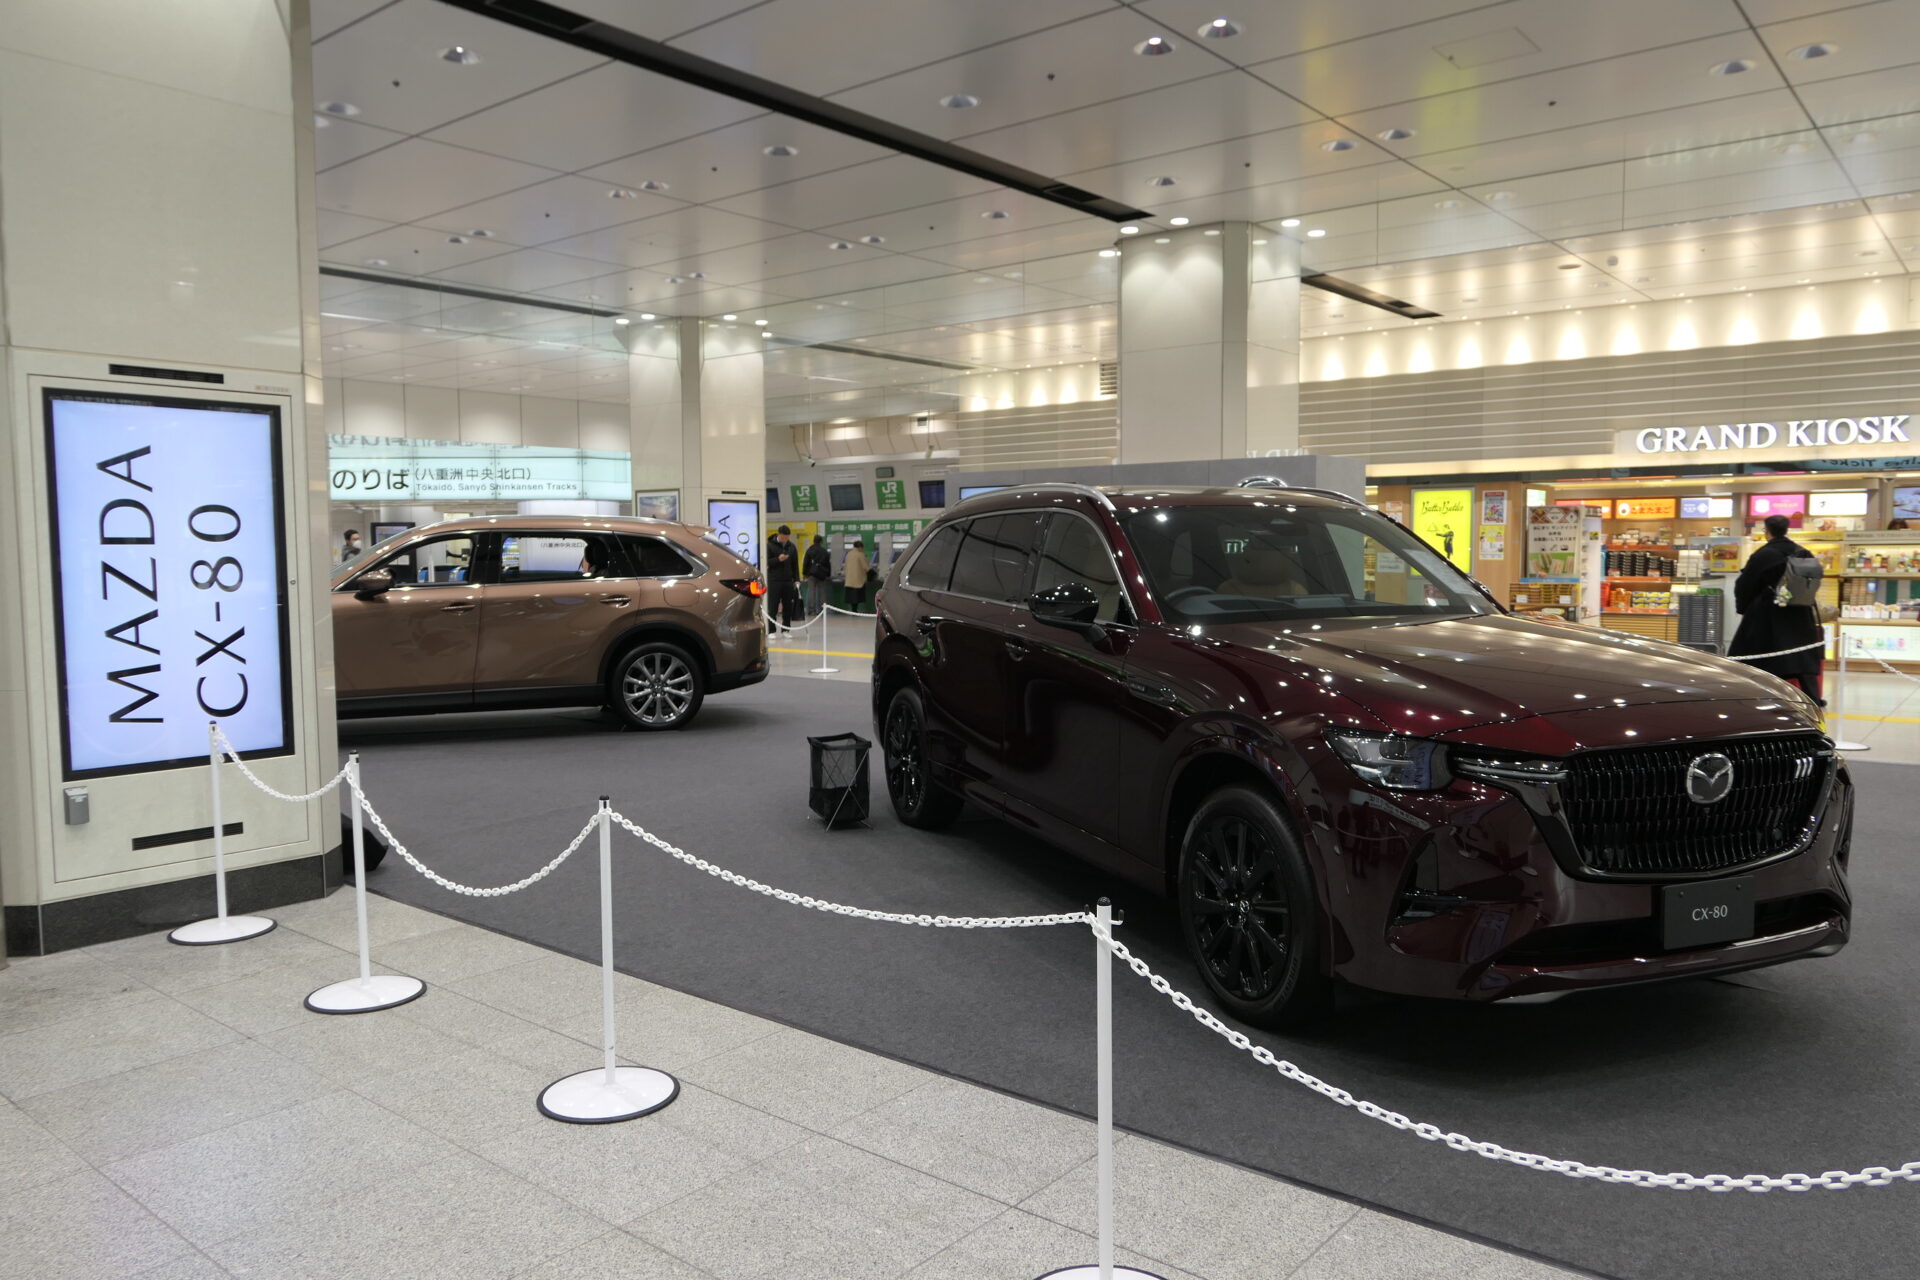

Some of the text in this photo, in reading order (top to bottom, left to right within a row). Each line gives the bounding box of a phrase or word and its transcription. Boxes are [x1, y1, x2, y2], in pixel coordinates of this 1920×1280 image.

[1636, 415, 1911, 453] GRAND KIOSK
[332, 468, 410, 491] のりば
[415, 467, 532, 481] (八重洲中央北口)
[489, 482, 544, 491] Shinkansen
[547, 482, 577, 491] Tracks
[796, 486, 811, 497] JR
[882, 482, 897, 493] JR
[96, 444, 164, 723] MAZDA
[187, 504, 248, 718] CX-80
[1692, 904, 1728, 921] CX-80
